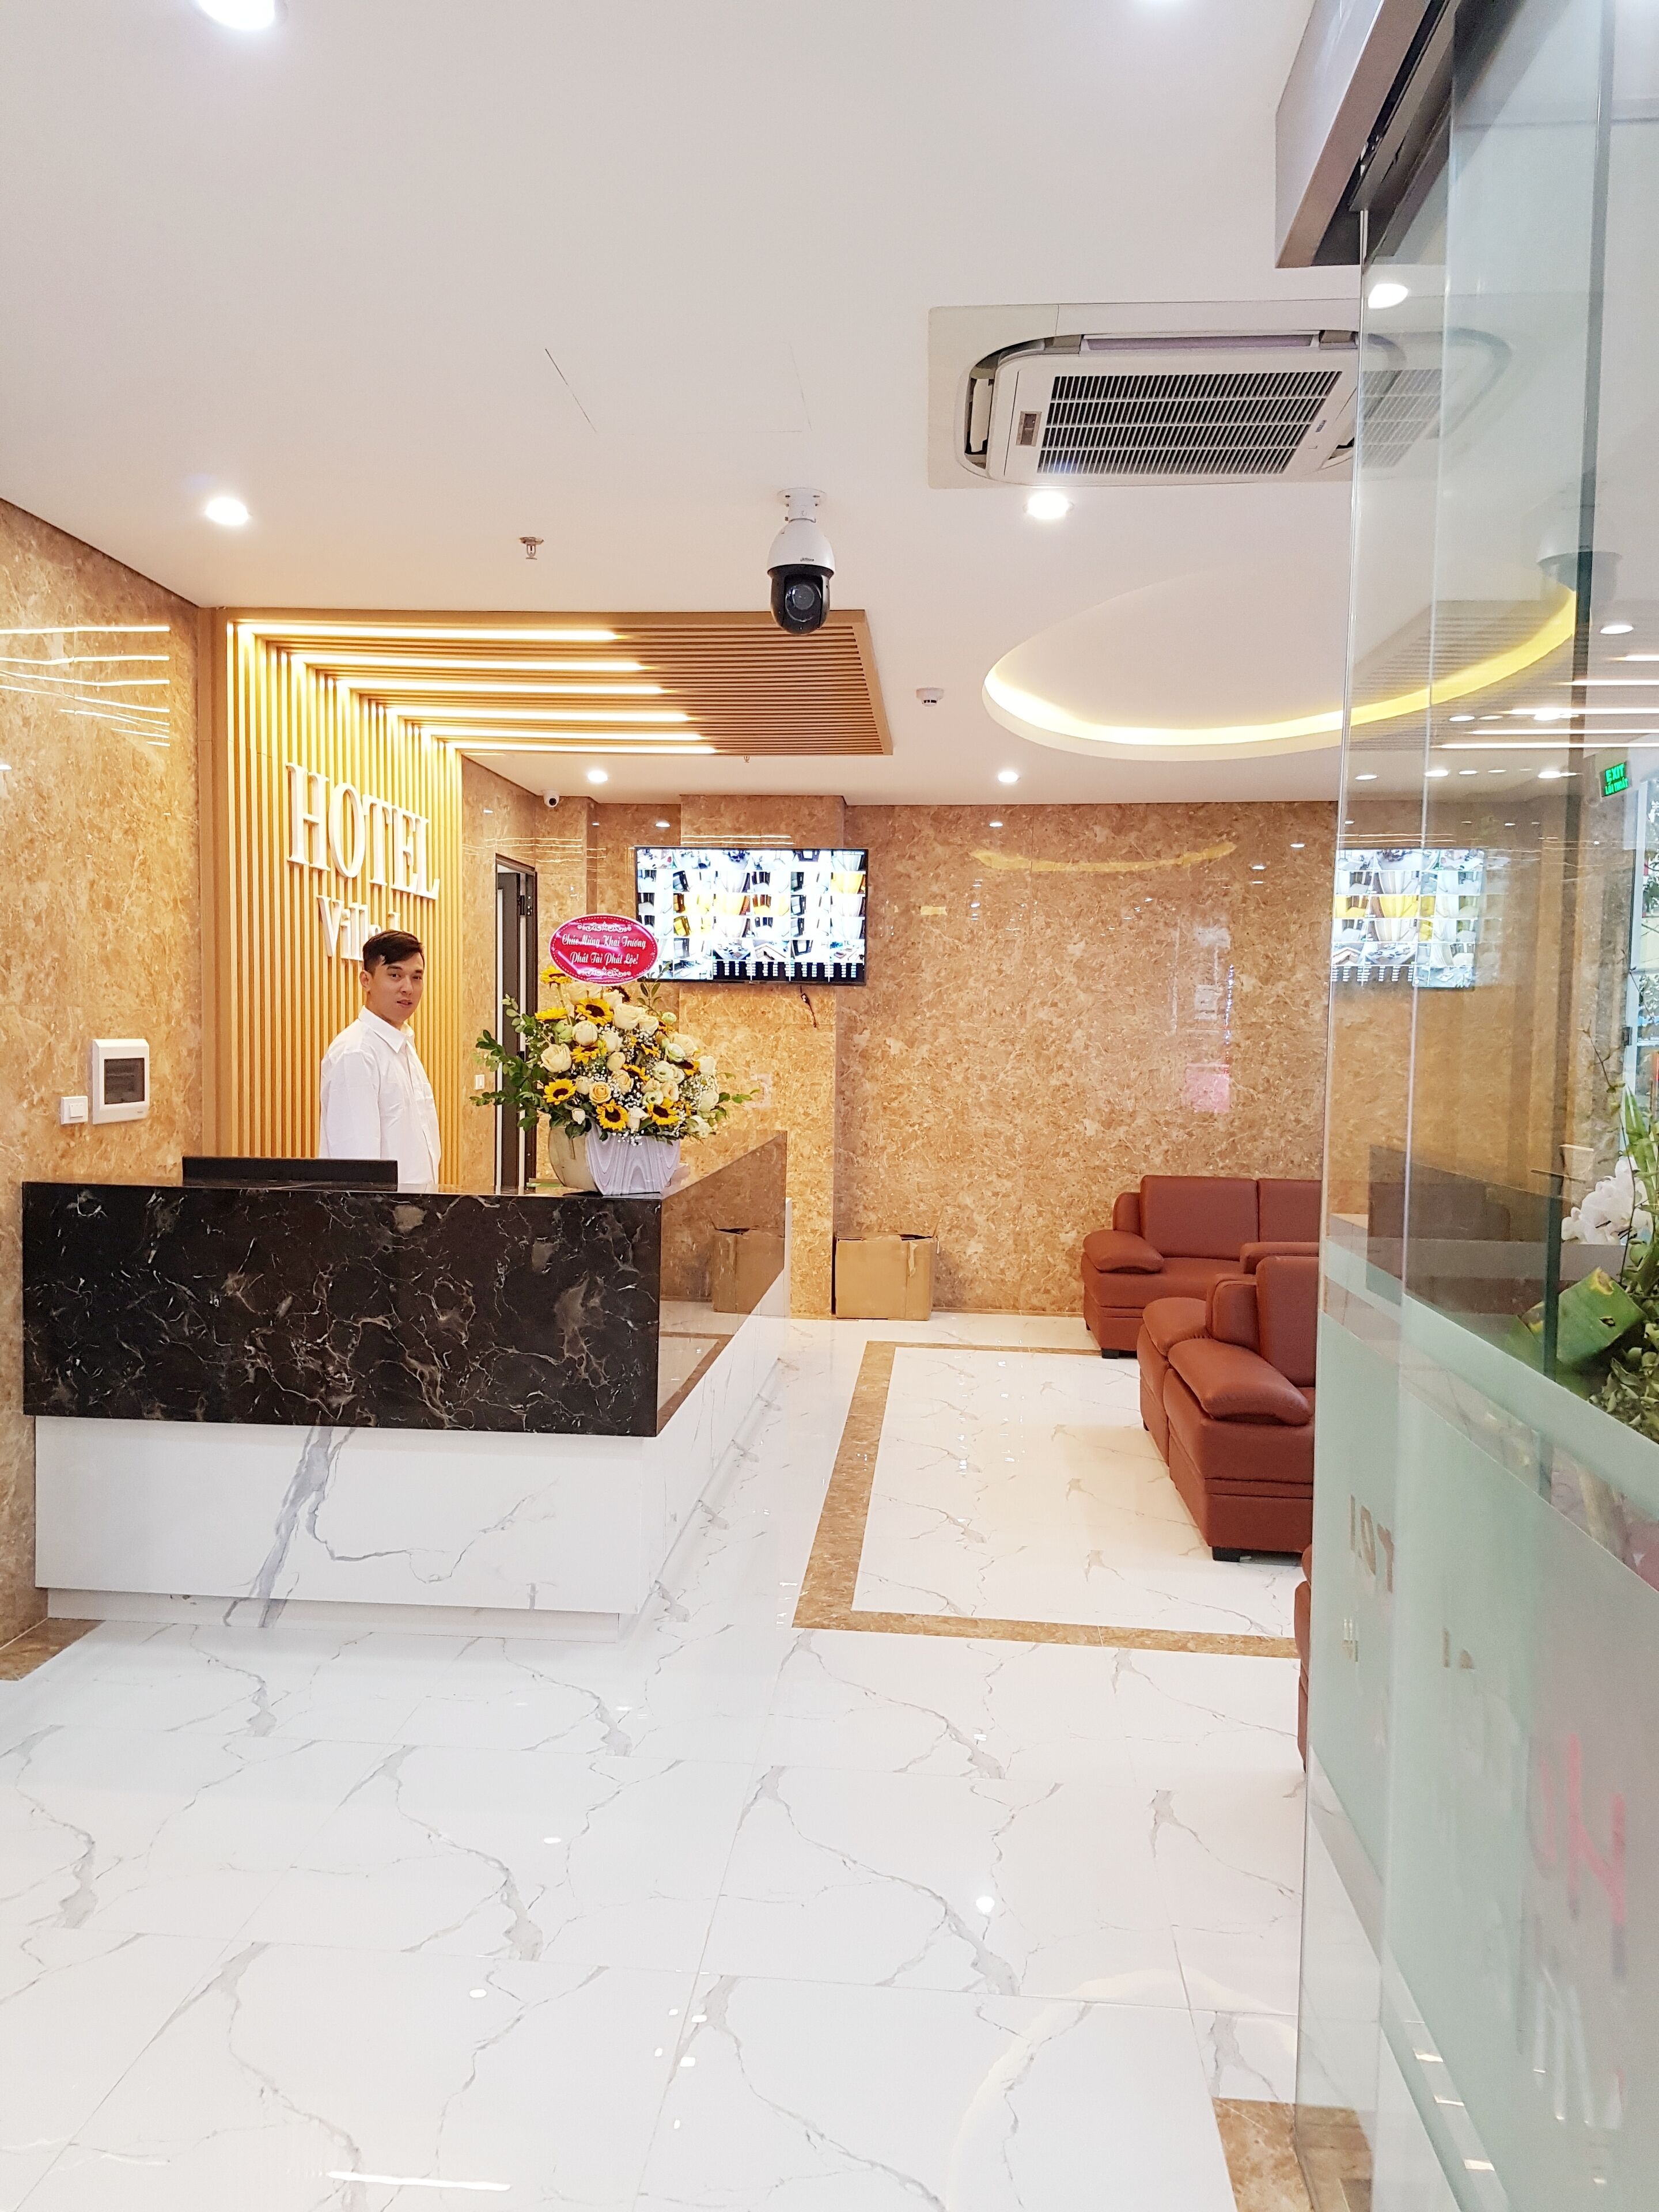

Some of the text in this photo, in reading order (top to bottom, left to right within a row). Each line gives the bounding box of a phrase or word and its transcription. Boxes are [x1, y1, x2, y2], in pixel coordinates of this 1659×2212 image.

[1605, 763, 1624, 782] EXIT
[286, 762, 440, 900] HOTEL
[562, 934, 579, 945] Chúc
[581, 934, 600, 948] Mừng
[603, 935, 620, 946] Khai
[570, 952, 639, 967] Phát Tài Phát Lộc!
